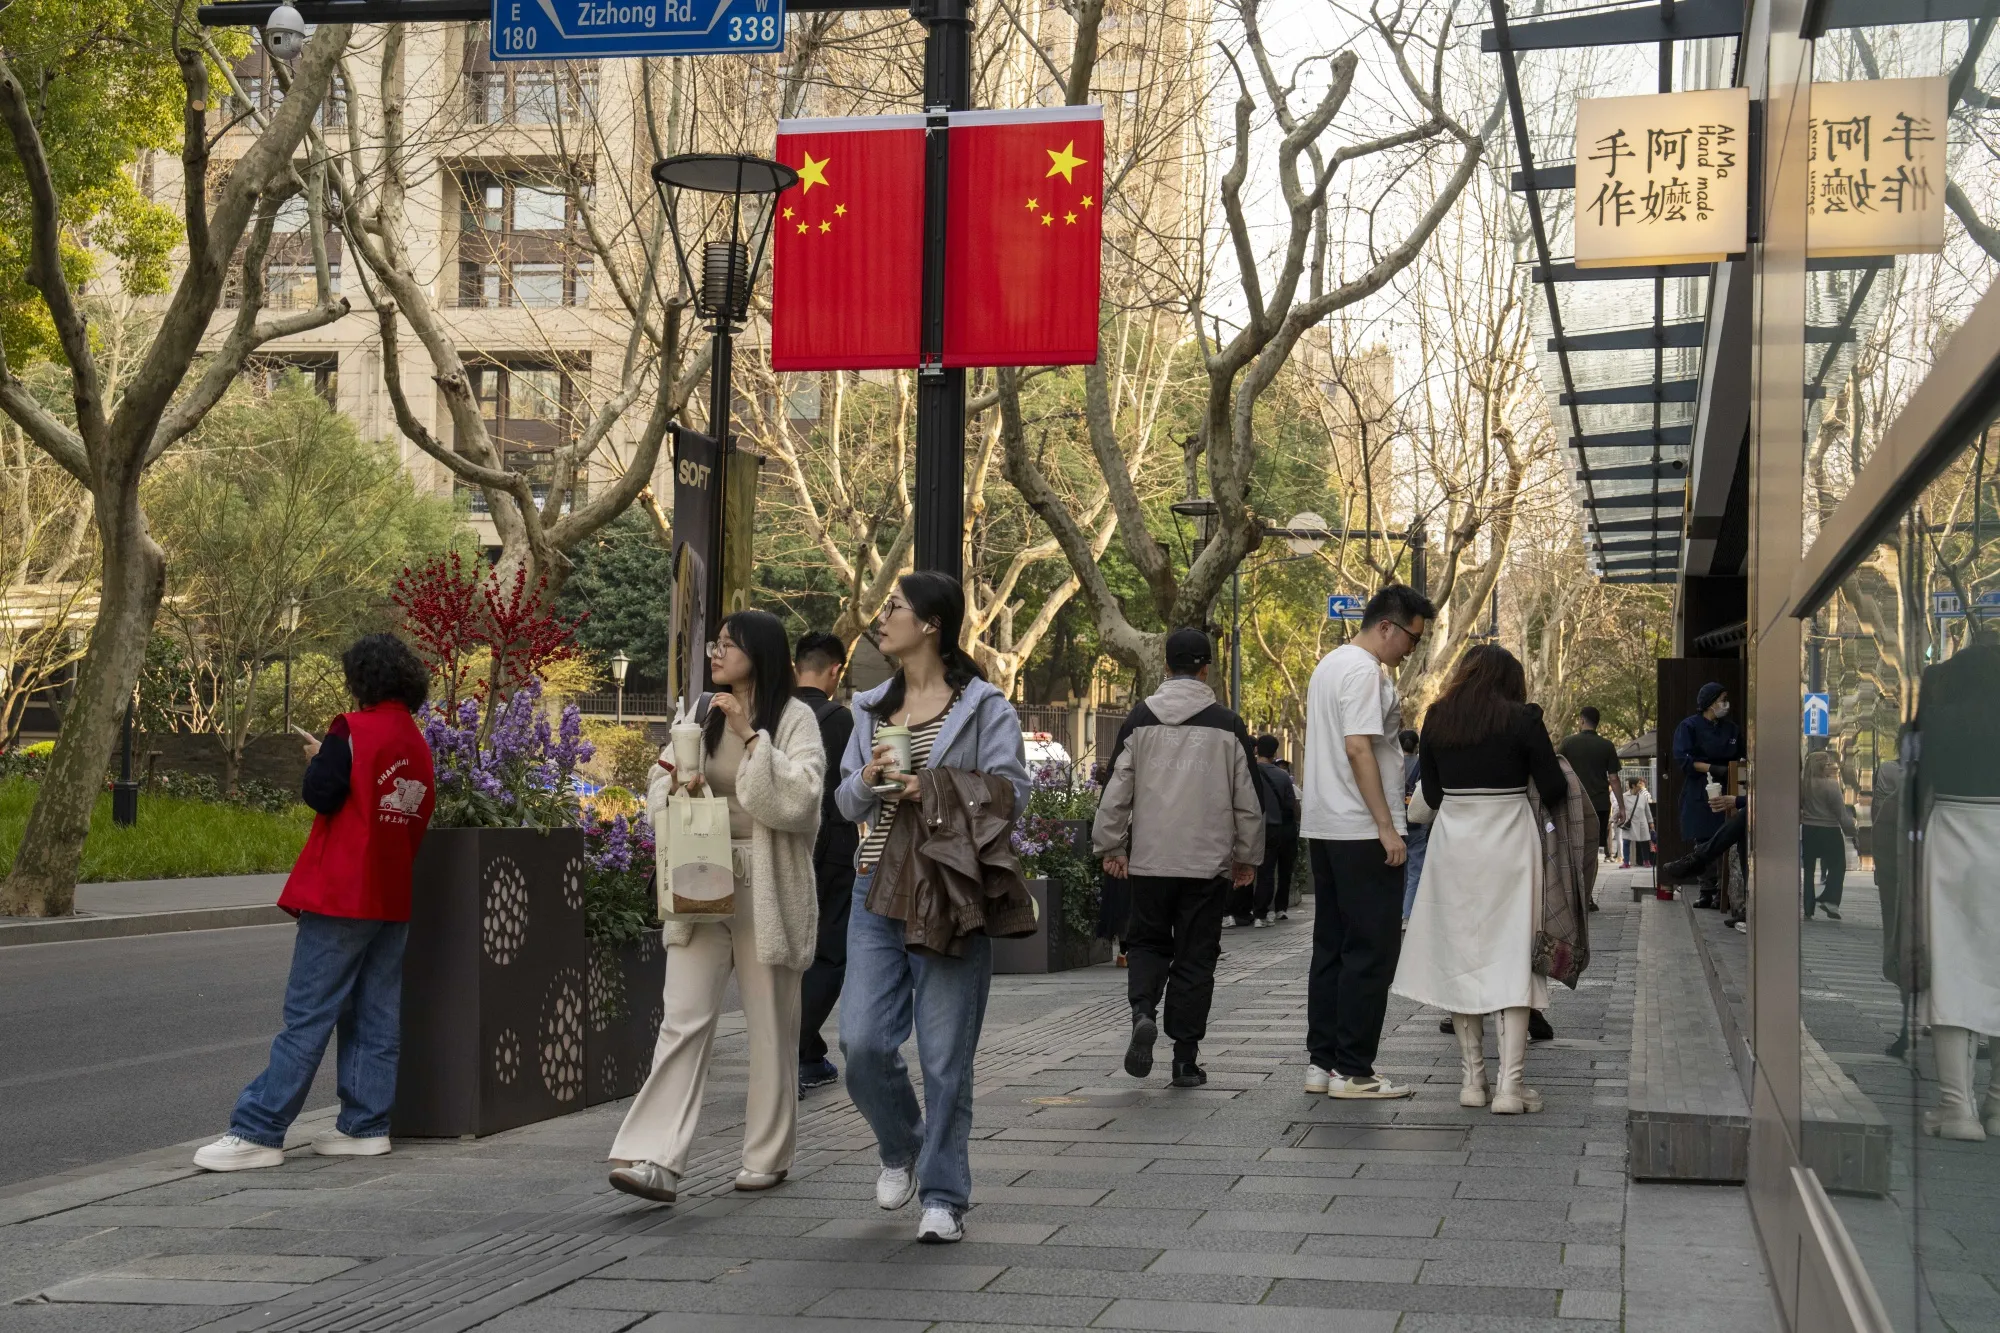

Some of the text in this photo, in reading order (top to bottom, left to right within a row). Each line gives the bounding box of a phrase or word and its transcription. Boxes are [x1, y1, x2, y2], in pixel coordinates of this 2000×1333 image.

[511, 3, 521, 21] E
[577, 1, 697, 28] Zizhong Rd.
[755, 0, 768, 12] W
[502, 27, 537, 50] 180
[728, 16, 775, 42] 338
[1717, 124, 1735, 179] Ah Ma
[1697, 125, 1716, 222] Hand made
[678, 458, 711, 491] SOFT
[1161, 727, 1208, 748] 保安
[1149, 756, 1213, 775] security
